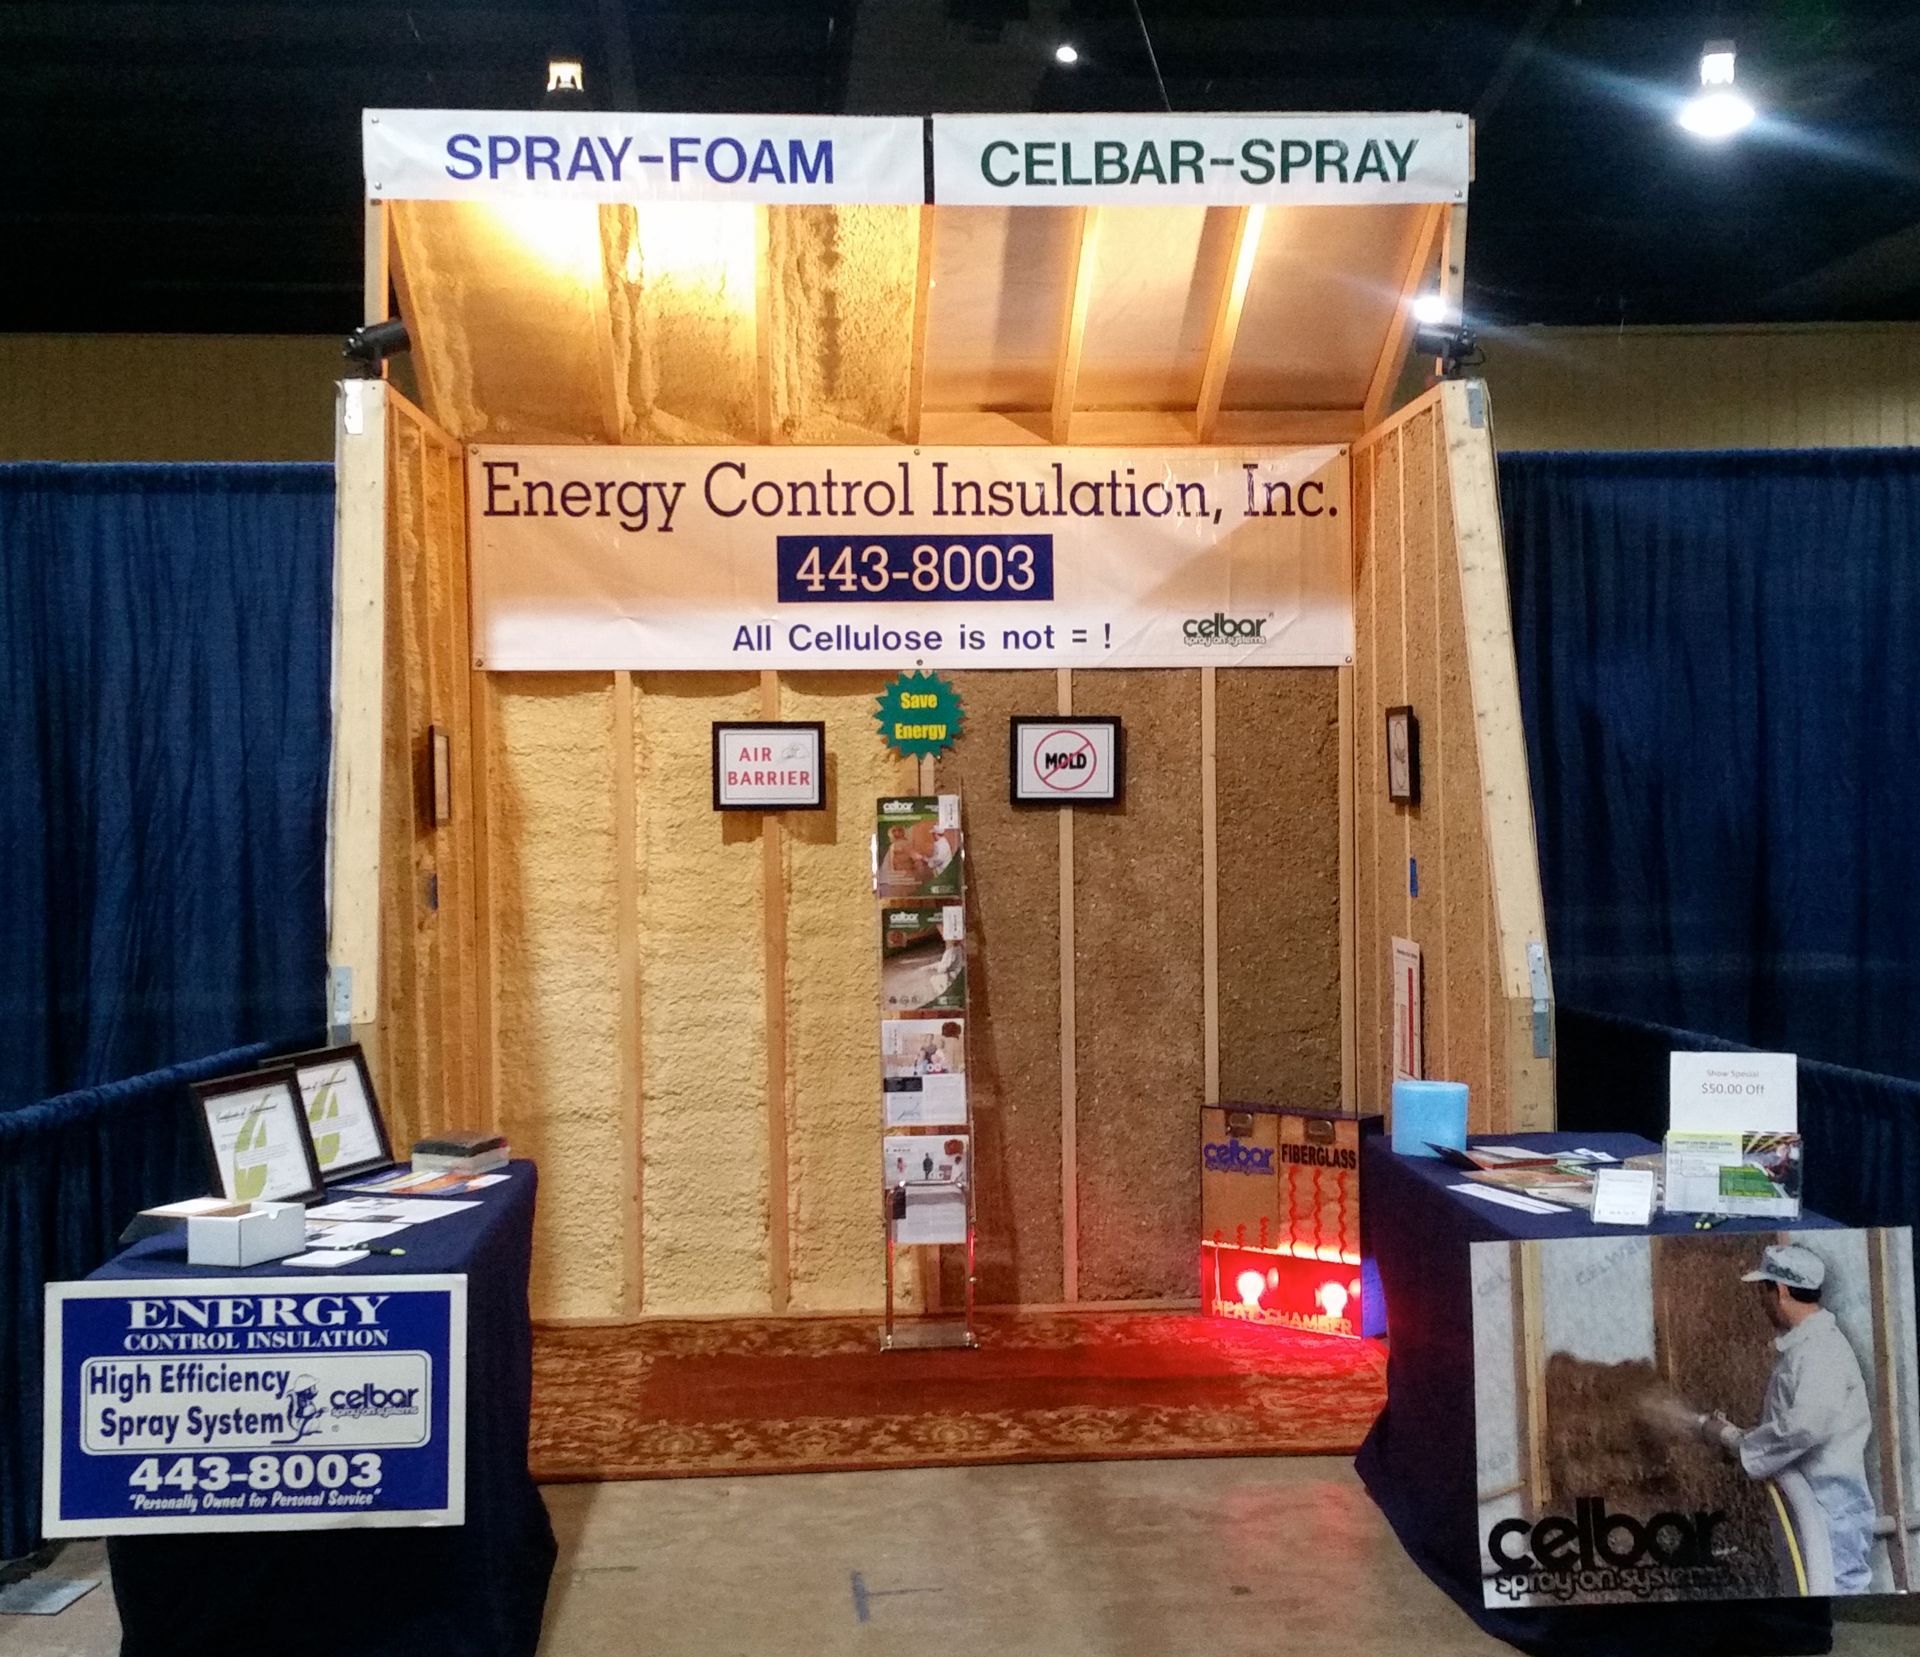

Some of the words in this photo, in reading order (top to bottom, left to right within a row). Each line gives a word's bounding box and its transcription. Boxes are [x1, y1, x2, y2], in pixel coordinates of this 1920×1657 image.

[445, 133, 834, 185] SPRAY-FOAM
[981, 138, 1420, 188] CELBAR-SPRAY
[483, 461, 686, 533] Energy
[704, 461, 915, 518] Control
[932, 462, 1222, 525] Insulation,
[1242, 463, 1339, 518] Inc.
[796, 544, 1036, 593] 443-8003
[733, 624, 772, 652] All
[788, 624, 943, 652] Cellulose
[959, 624, 986, 650] is
[1002, 625, 1055, 650] not
[1183, 613, 1267, 637] celbar
[900, 692, 938, 709] Save
[895, 723, 947, 740] Energy
[739, 747, 772, 763] AIR
[1045, 753, 1087, 769] MOLD
[728, 771, 811, 787] BARRIER
[1706, 1069, 1727, 1078] Show
[1730, 1069, 1760, 1079] Special
[1701, 1082, 1743, 1096] $50.00
[1746, 1083, 1765, 1096] Off
[1281, 1143, 1357, 1170] FIBERGLASS
[127, 1296, 390, 1329] ENERGY
[123, 1332, 239, 1351] CONTROL
[247, 1329, 389, 1349] INSULATION
[90, 1363, 150, 1402] High
[160, 1363, 290, 1400] Efficiency
[330, 1383, 419, 1408] celbar
[101, 1407, 180, 1445] Spray
[187, 1406, 284, 1444] System
[129, 1453, 382, 1491] 443-8003
[202, 1492, 245, 1509] Owned
[249, 1492, 268, 1507] for
[271, 1490, 325, 1507] Personal
[1488, 1497, 1728, 1570] celbar
